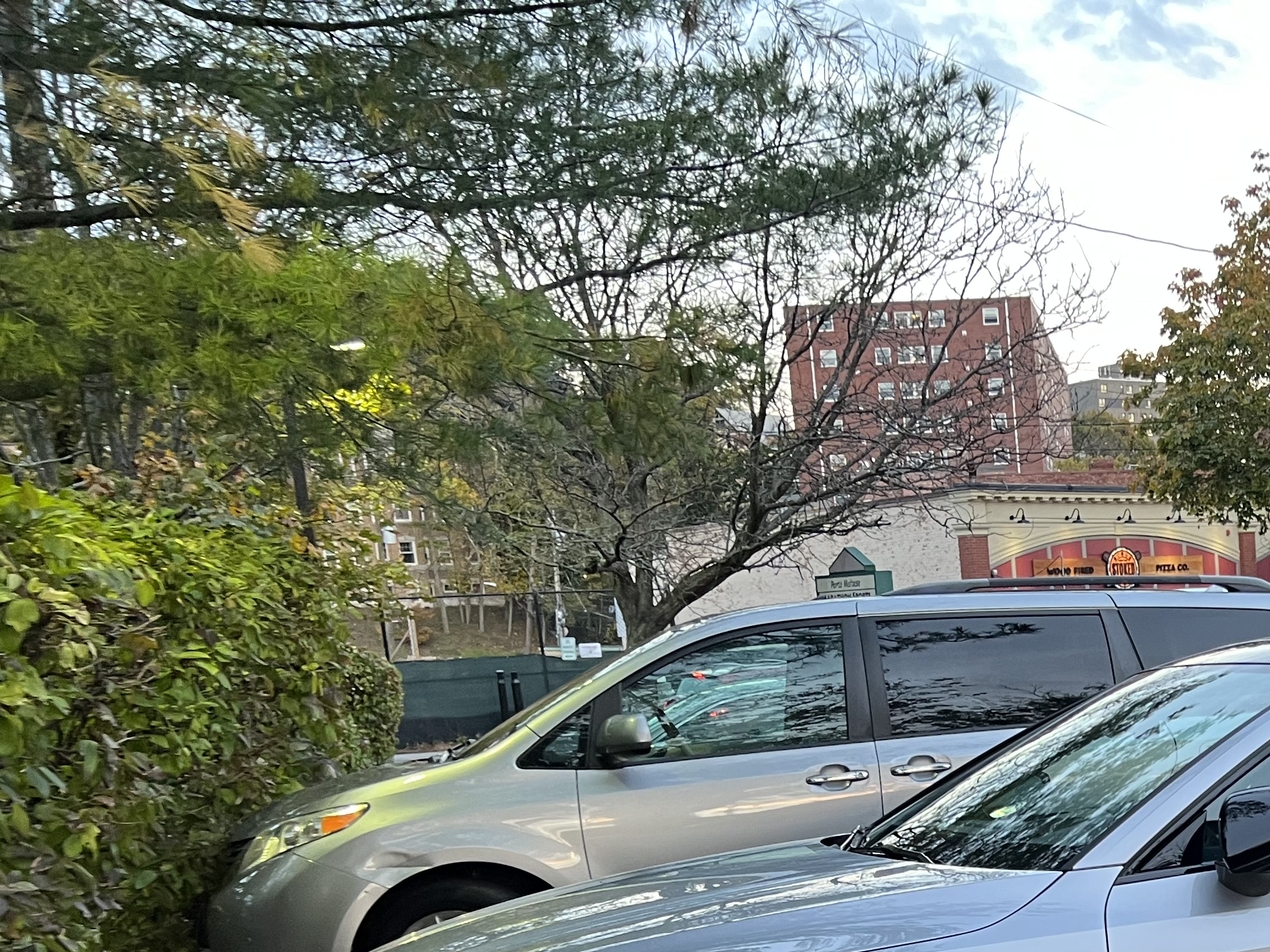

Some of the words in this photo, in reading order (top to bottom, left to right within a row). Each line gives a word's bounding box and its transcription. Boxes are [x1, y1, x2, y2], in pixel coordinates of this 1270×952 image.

[1047, 567, 1071, 576] WOOD
[1074, 566, 1094, 575] FIRED
[1112, 562, 1135, 576] STOKED
[1156, 564, 1176, 572] PIZZA
[1177, 563, 1190, 571] CO.
